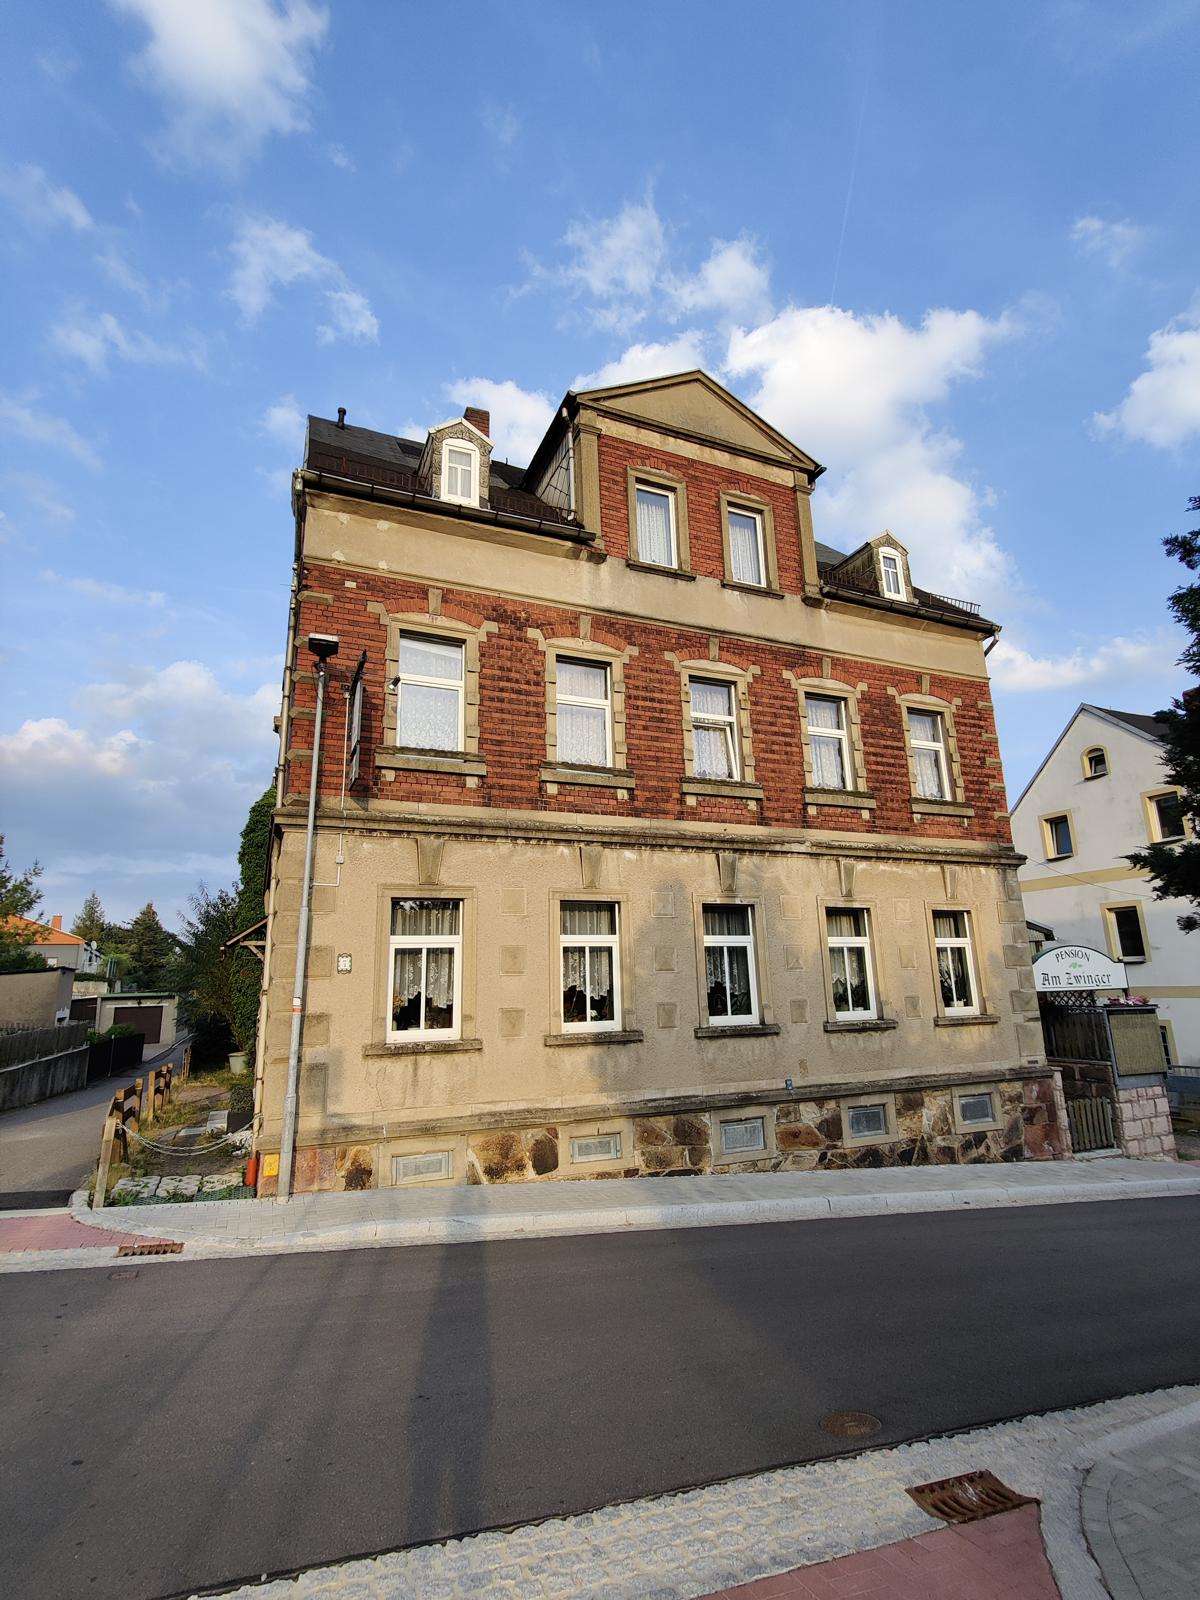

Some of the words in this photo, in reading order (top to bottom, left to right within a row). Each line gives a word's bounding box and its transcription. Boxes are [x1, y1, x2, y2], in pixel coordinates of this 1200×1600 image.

[1055, 949, 1091, 963] PENSION
[1041, 972, 1062, 986] Am
[1065, 971, 1112, 987] Zwinger
